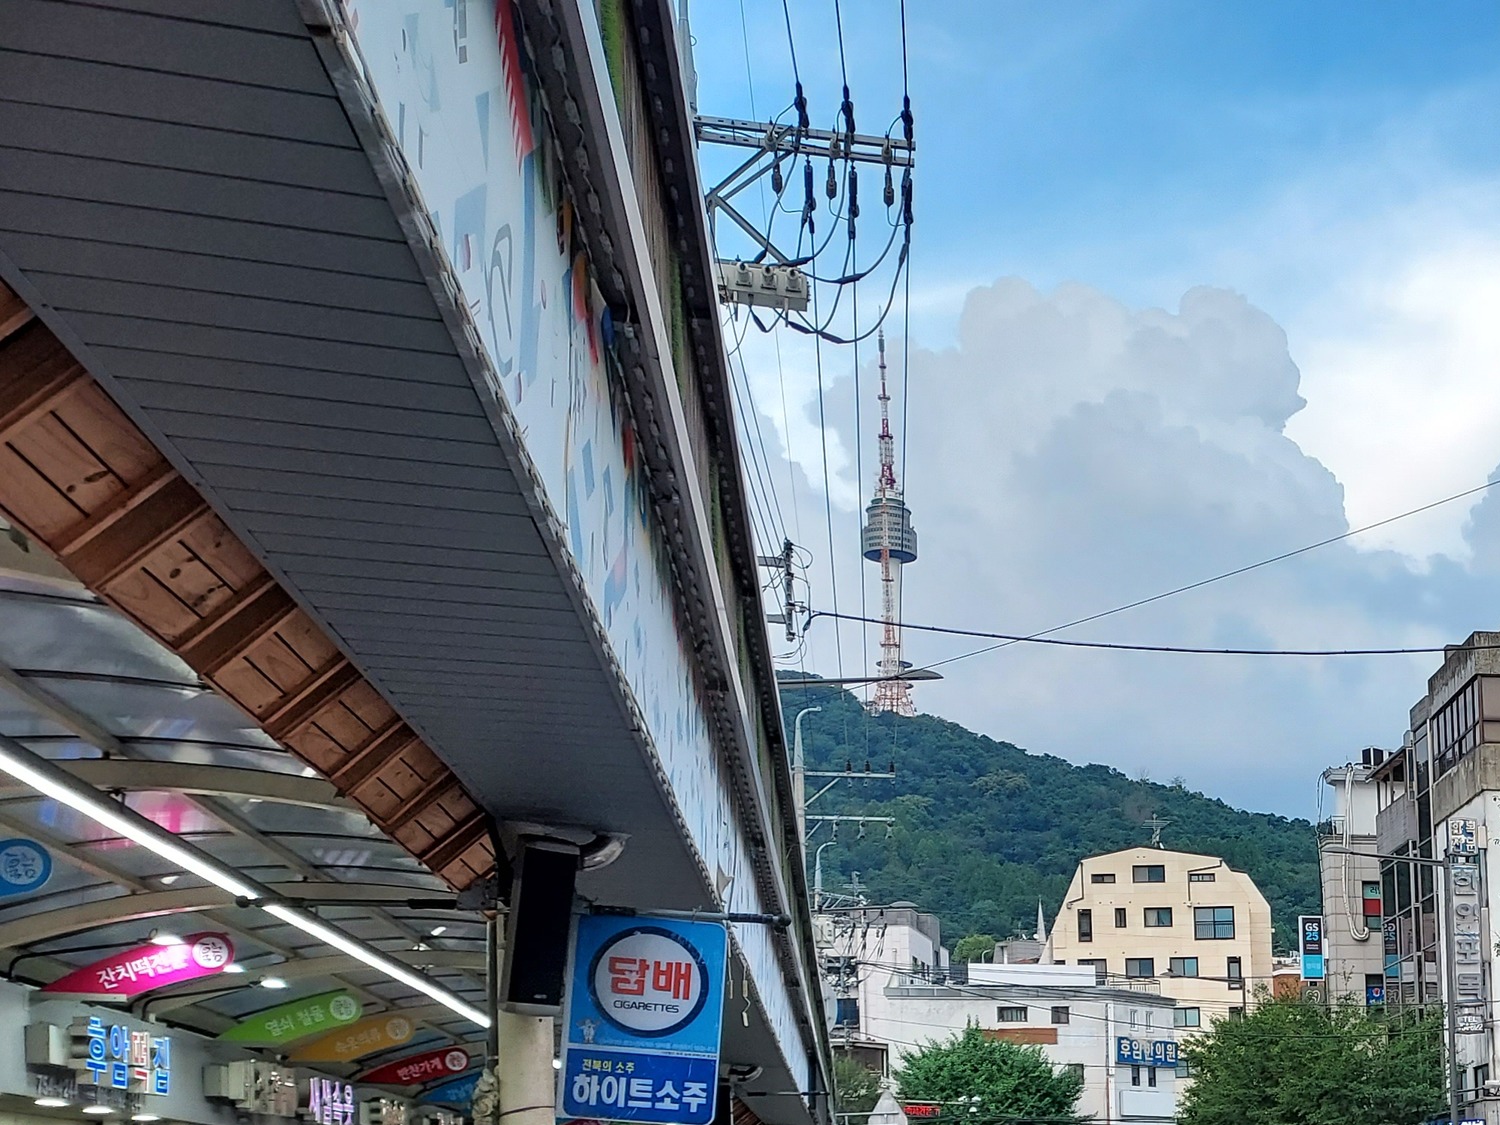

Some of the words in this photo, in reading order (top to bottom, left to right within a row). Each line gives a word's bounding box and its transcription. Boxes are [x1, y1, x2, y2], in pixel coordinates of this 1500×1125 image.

[1305, 922, 1319, 932] GS
[1305, 932, 1319, 941] 25
[608, 956, 692, 1000] 담배
[613, 1000, 680, 1014] CIGARETTES
[86, 1016, 171, 1096] 후암떡집
[1120, 1039, 1176, 1063] 후암한의원
[396, 1057, 443, 1081] 반찬가게
[615, 1061, 636, 1073] 소주
[572, 1073, 708, 1113] 하이트소주
